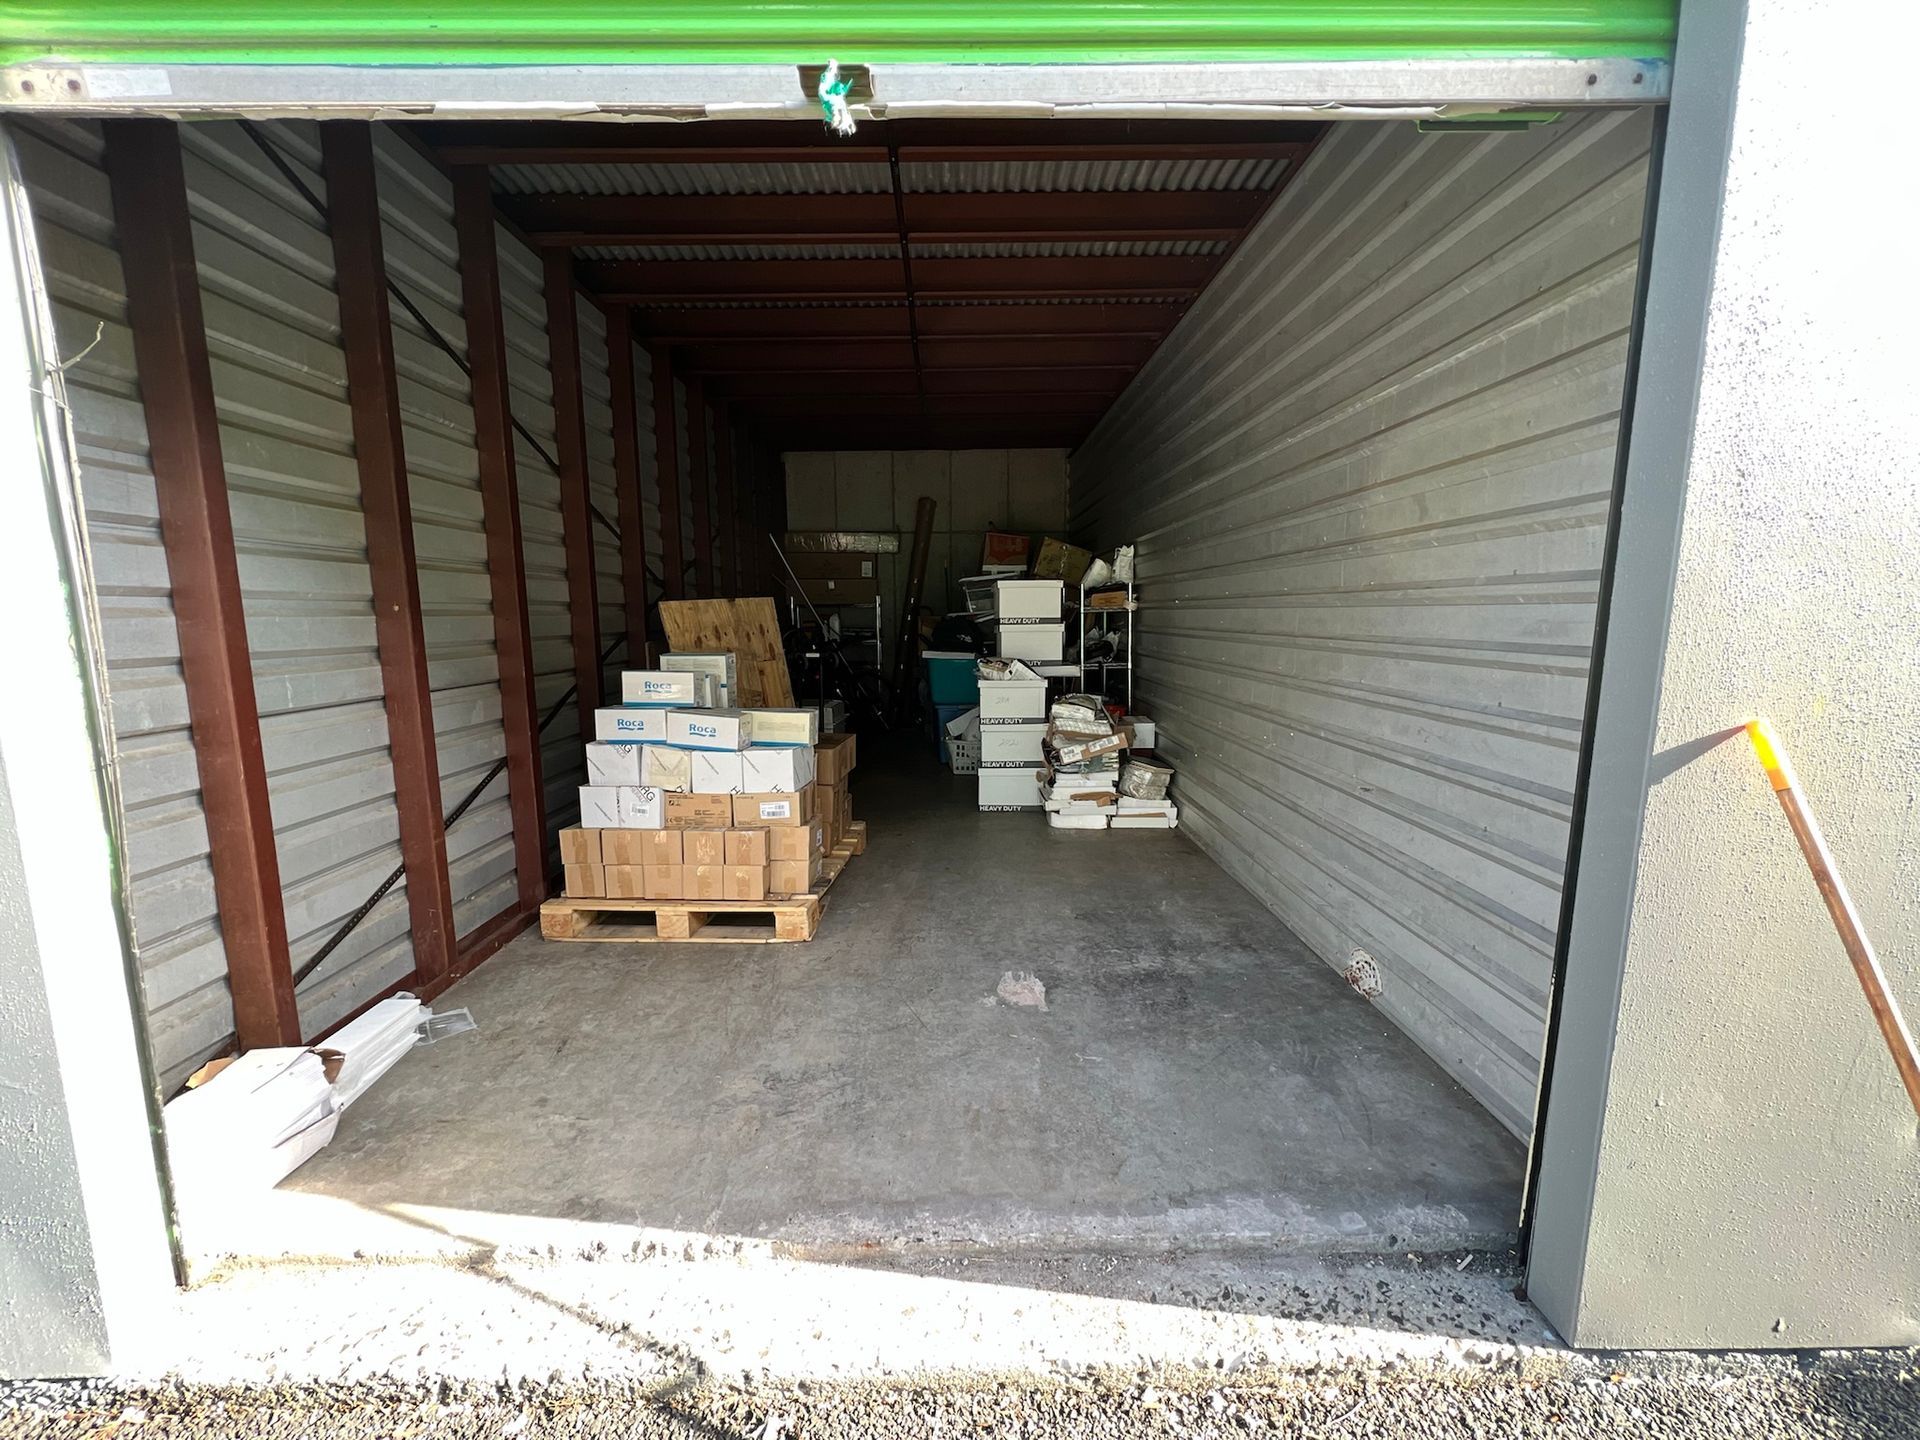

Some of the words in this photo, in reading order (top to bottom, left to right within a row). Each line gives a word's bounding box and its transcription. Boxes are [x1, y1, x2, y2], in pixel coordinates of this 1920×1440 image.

[644, 681, 672, 690] Roca
[617, 718, 644, 727] Roca
[689, 723, 717, 734] Roca
